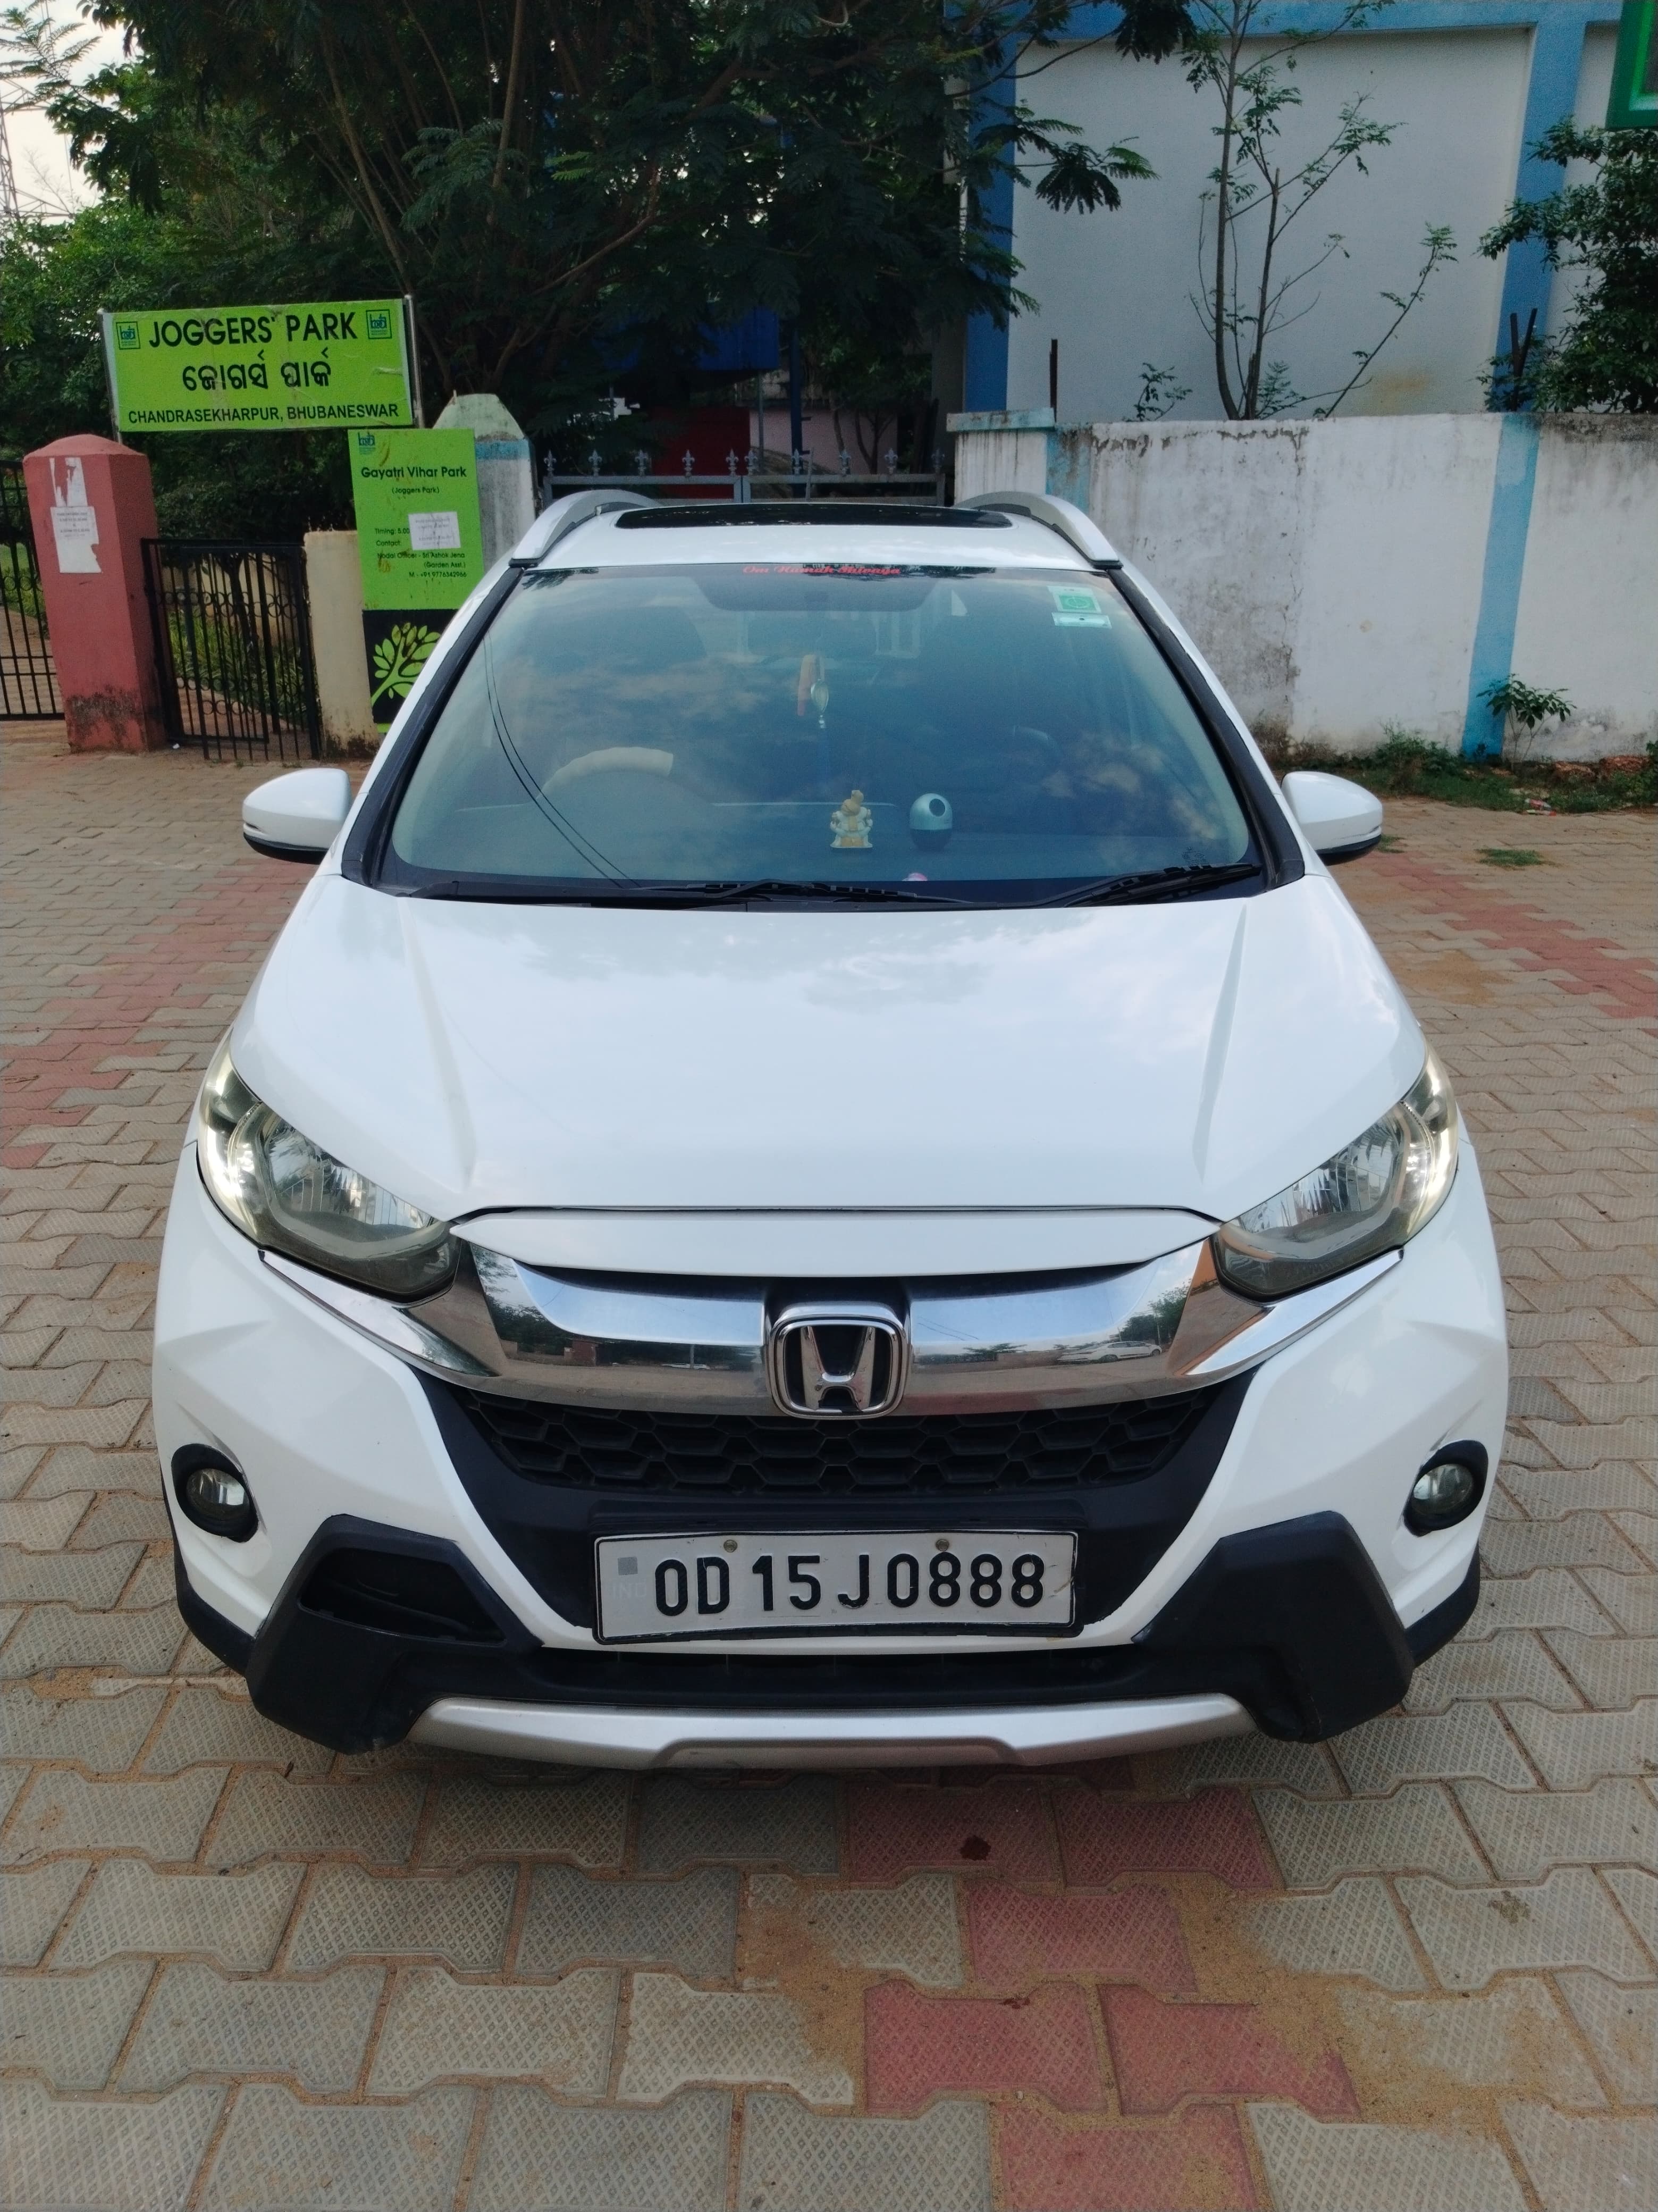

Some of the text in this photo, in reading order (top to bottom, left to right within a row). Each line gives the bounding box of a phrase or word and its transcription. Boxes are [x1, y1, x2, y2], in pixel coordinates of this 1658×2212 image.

[149, 312, 358, 347] JOGGERS' PARK
[182, 347, 331, 391] ଜୋଗର୍ସ ପାର୍କ
[128, 403, 399, 424] CHANDRASEKHARPUR, BHUBANESWAR
[361, 466, 467, 480] Gayatri Vihar Park
